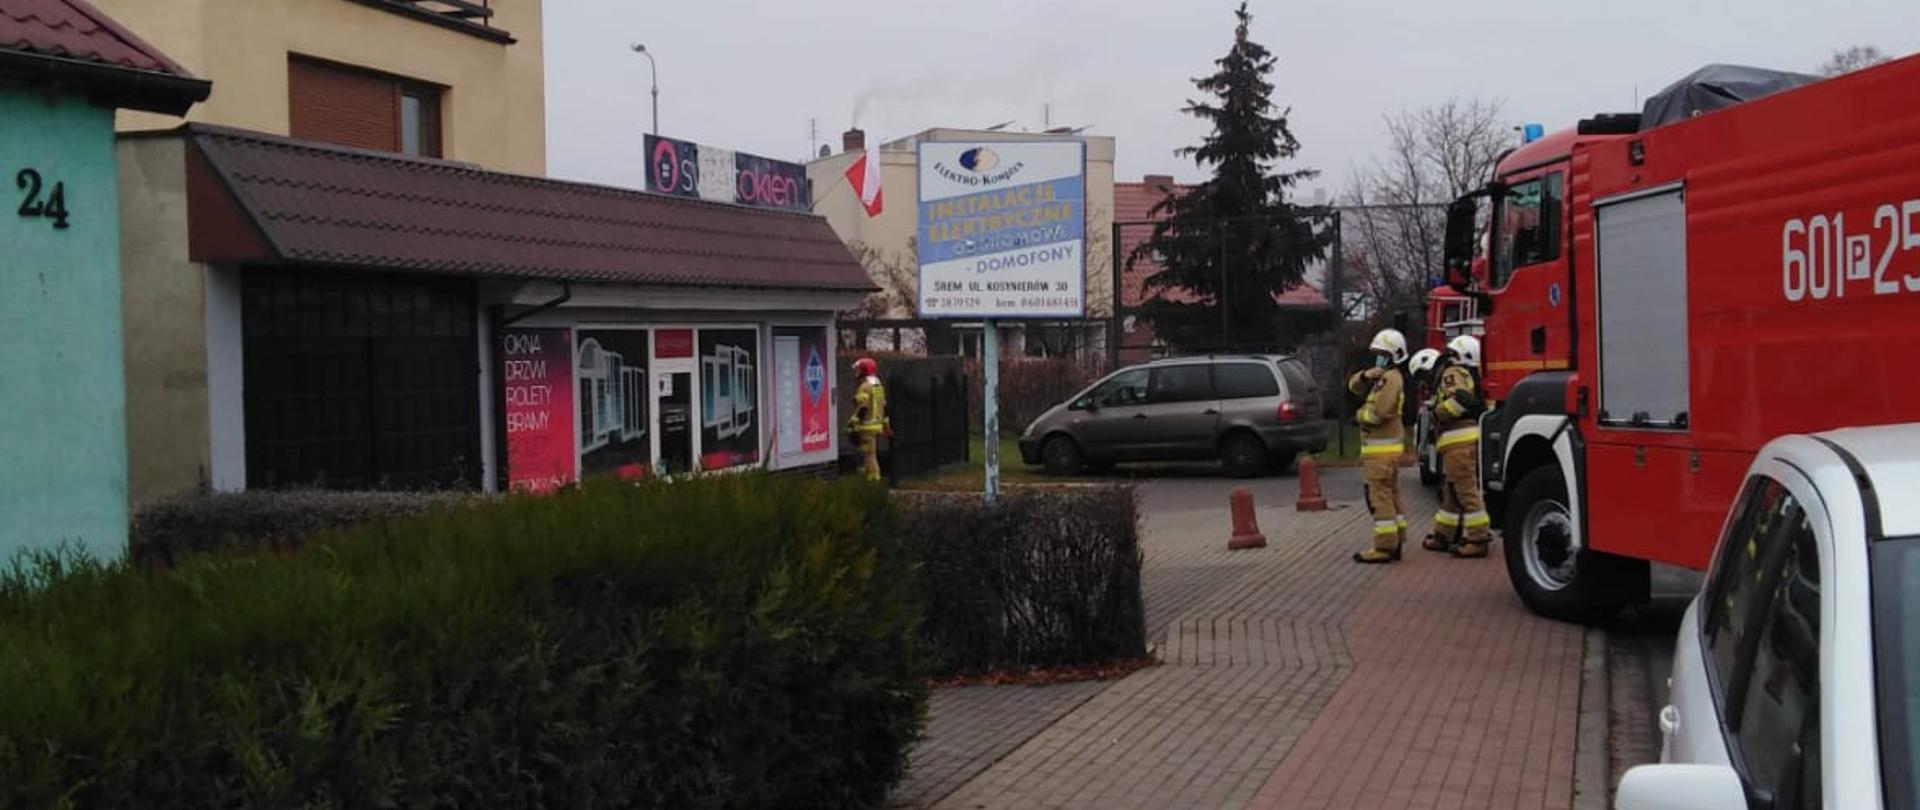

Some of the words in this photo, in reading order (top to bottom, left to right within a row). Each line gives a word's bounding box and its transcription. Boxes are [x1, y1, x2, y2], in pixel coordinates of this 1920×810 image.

[17, 168, 69, 228] 24
[928, 183, 1055, 221] INSTALACJE
[929, 204, 1073, 242] ELEKTRYCZNE
[976, 245, 1075, 274] DOMOFONY
[504, 334, 542, 355] OKNA
[505, 359, 547, 381] DRZWI
[506, 385, 552, 408] ROLETY
[507, 410, 551, 433] BRAMY
